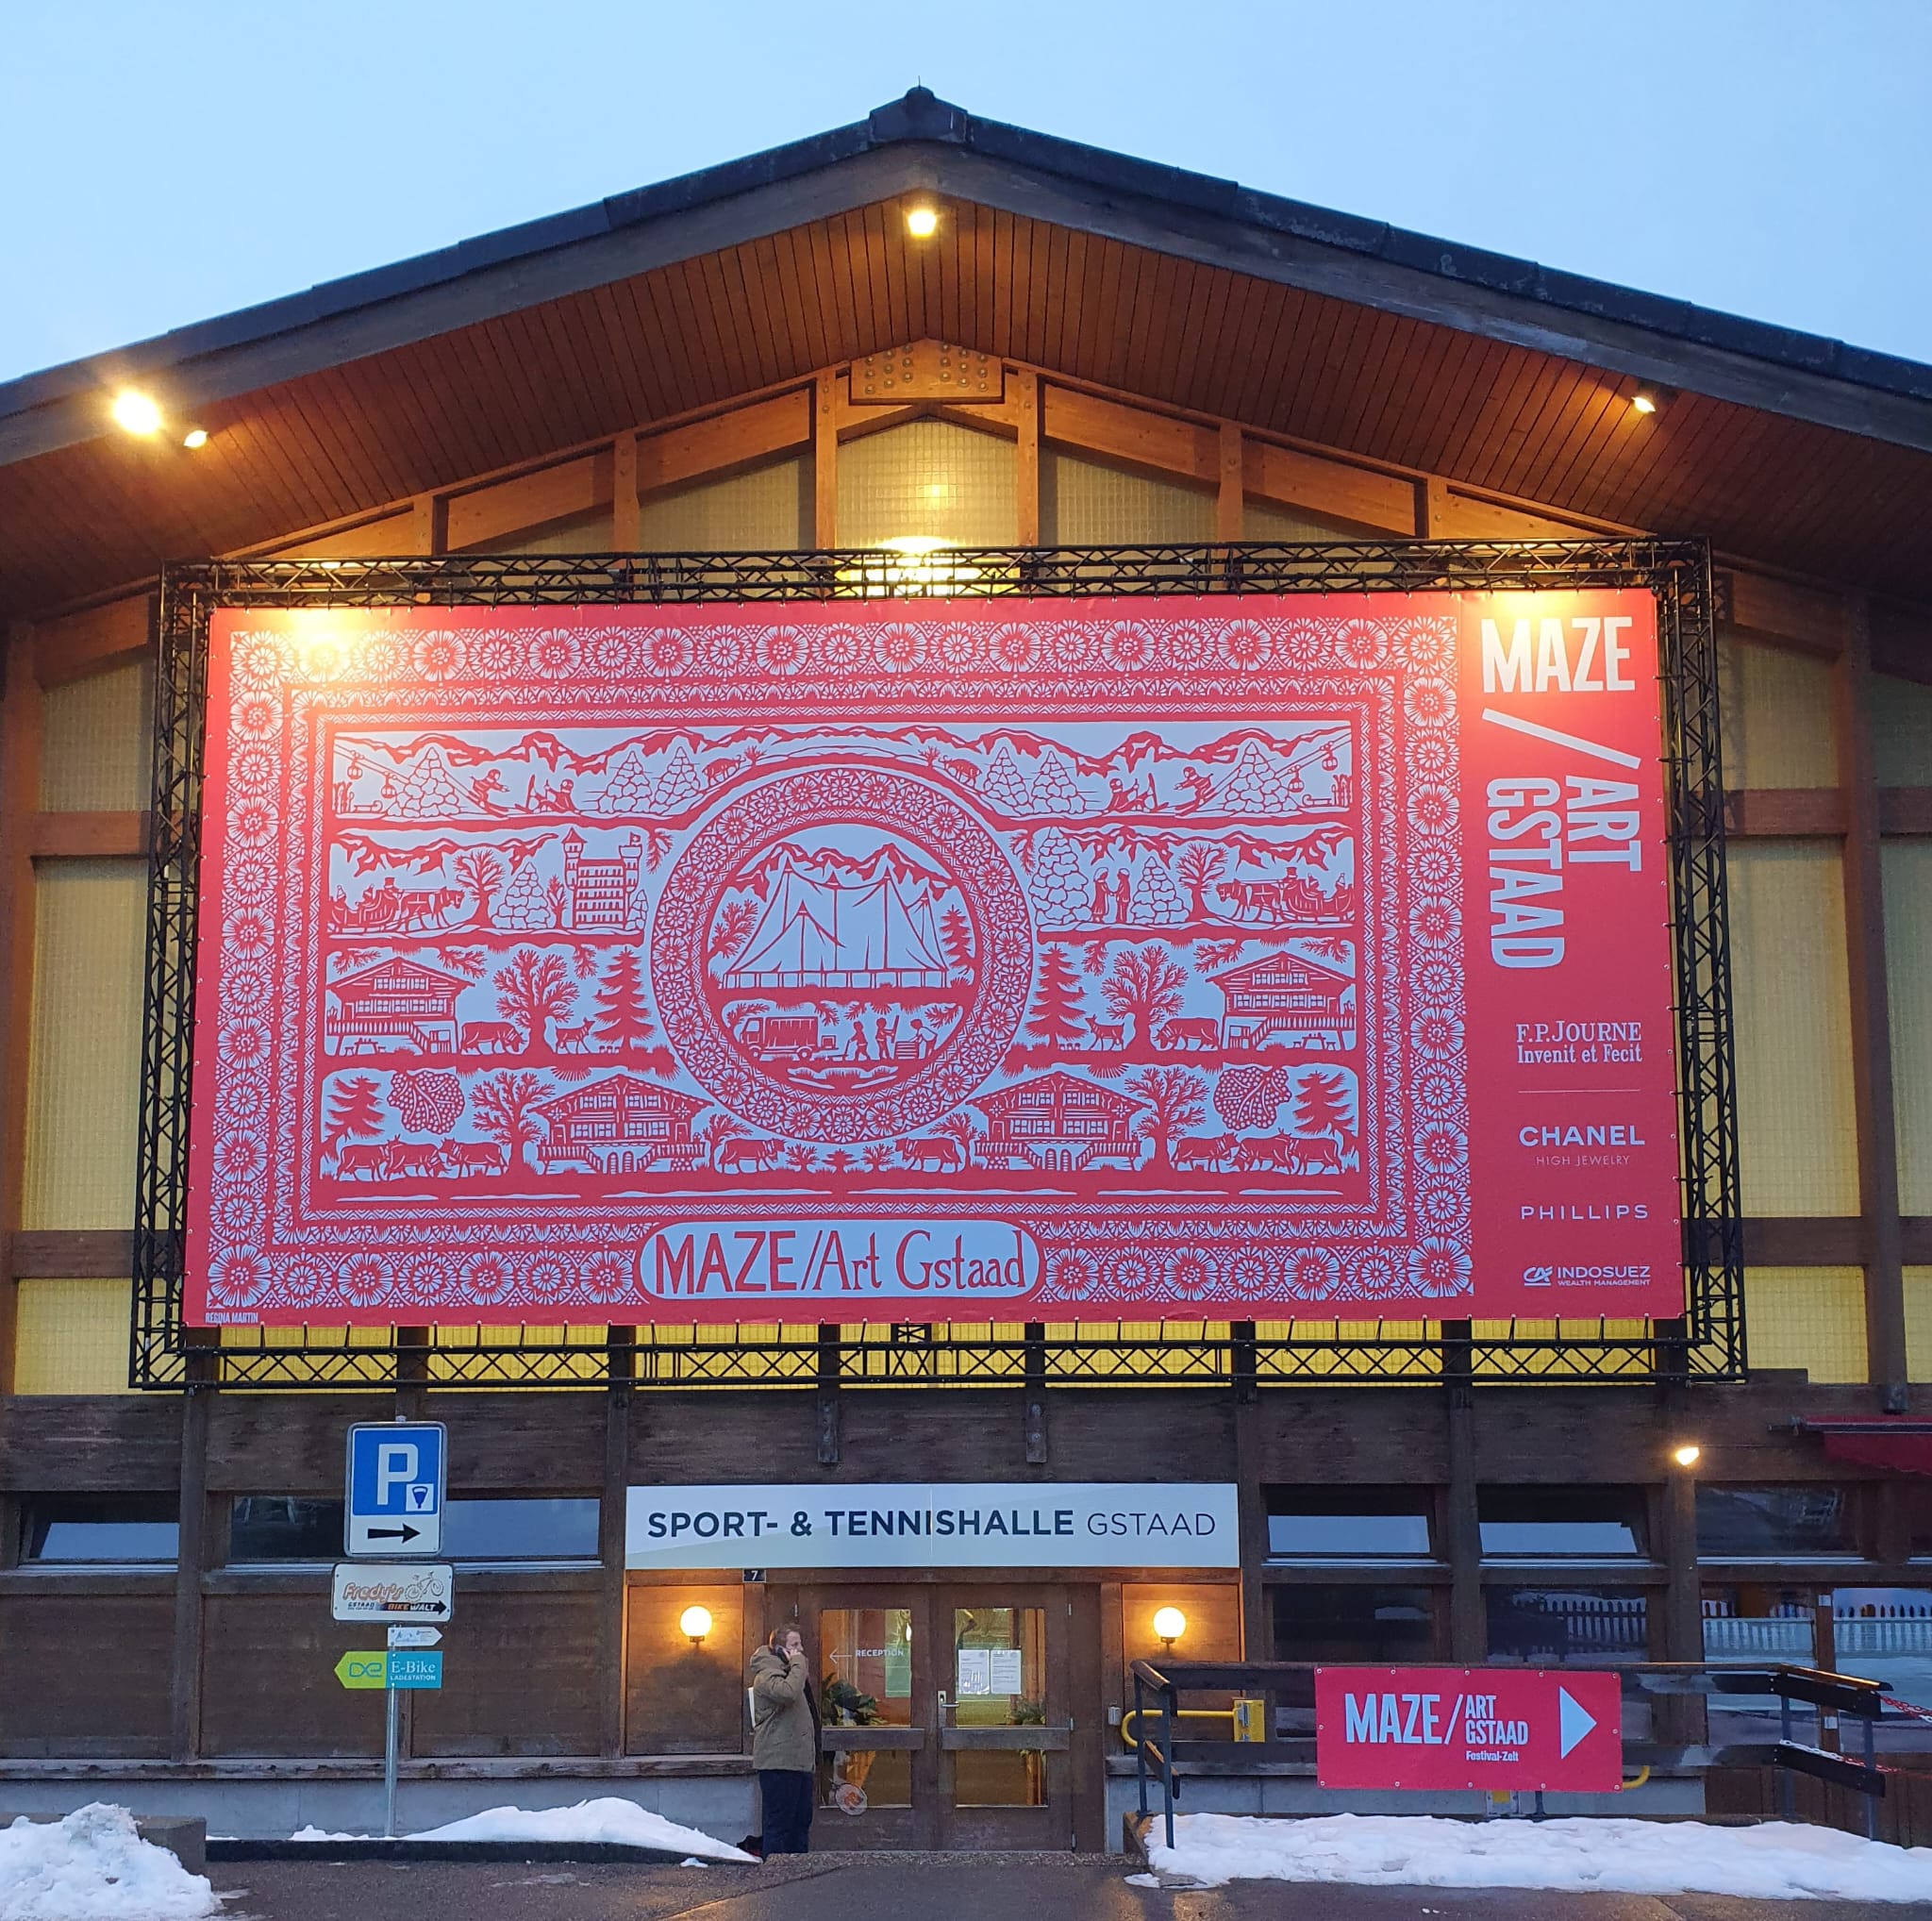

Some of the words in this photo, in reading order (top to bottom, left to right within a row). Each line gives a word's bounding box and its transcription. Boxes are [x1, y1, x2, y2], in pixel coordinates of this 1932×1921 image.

[1481, 616, 1636, 694] MAZE
[1565, 775, 1641, 872] ART
[1487, 777, 1565, 969] GSTAAD
[1516, 1021, 1642, 1043] F.P.JOURNE
[1517, 1044, 1576, 1063] Invenit
[1582, 1045, 1598, 1063] et
[1603, 1044, 1642, 1062] Fecit
[1519, 1126, 1646, 1147] CHANEL
[1536, 1155, 1571, 1165] HIGH
[1574, 1155, 1631, 1166] JEWELRY
[1521, 1205, 1649, 1220] PHILLIPS
[895, 1229, 1026, 1291] Gstaad
[1557, 1265, 1651, 1278] INDOSUEZ
[376, 1444, 418, 1506] P
[648, 1511, 778, 1538] SPORT-
[791, 1511, 812, 1535] &
[824, 1509, 1074, 1536] TENNISHALLE
[1087, 1512, 1215, 1536] GSTAAD
[751, 1571, 758, 1581] 7
[342, 1582, 404, 1603] Fredy's
[391, 1662, 436, 1674] E-Bike
[1465, 1695, 1496, 1718] ART
[1465, 1720, 1528, 1745] GSTAAD
